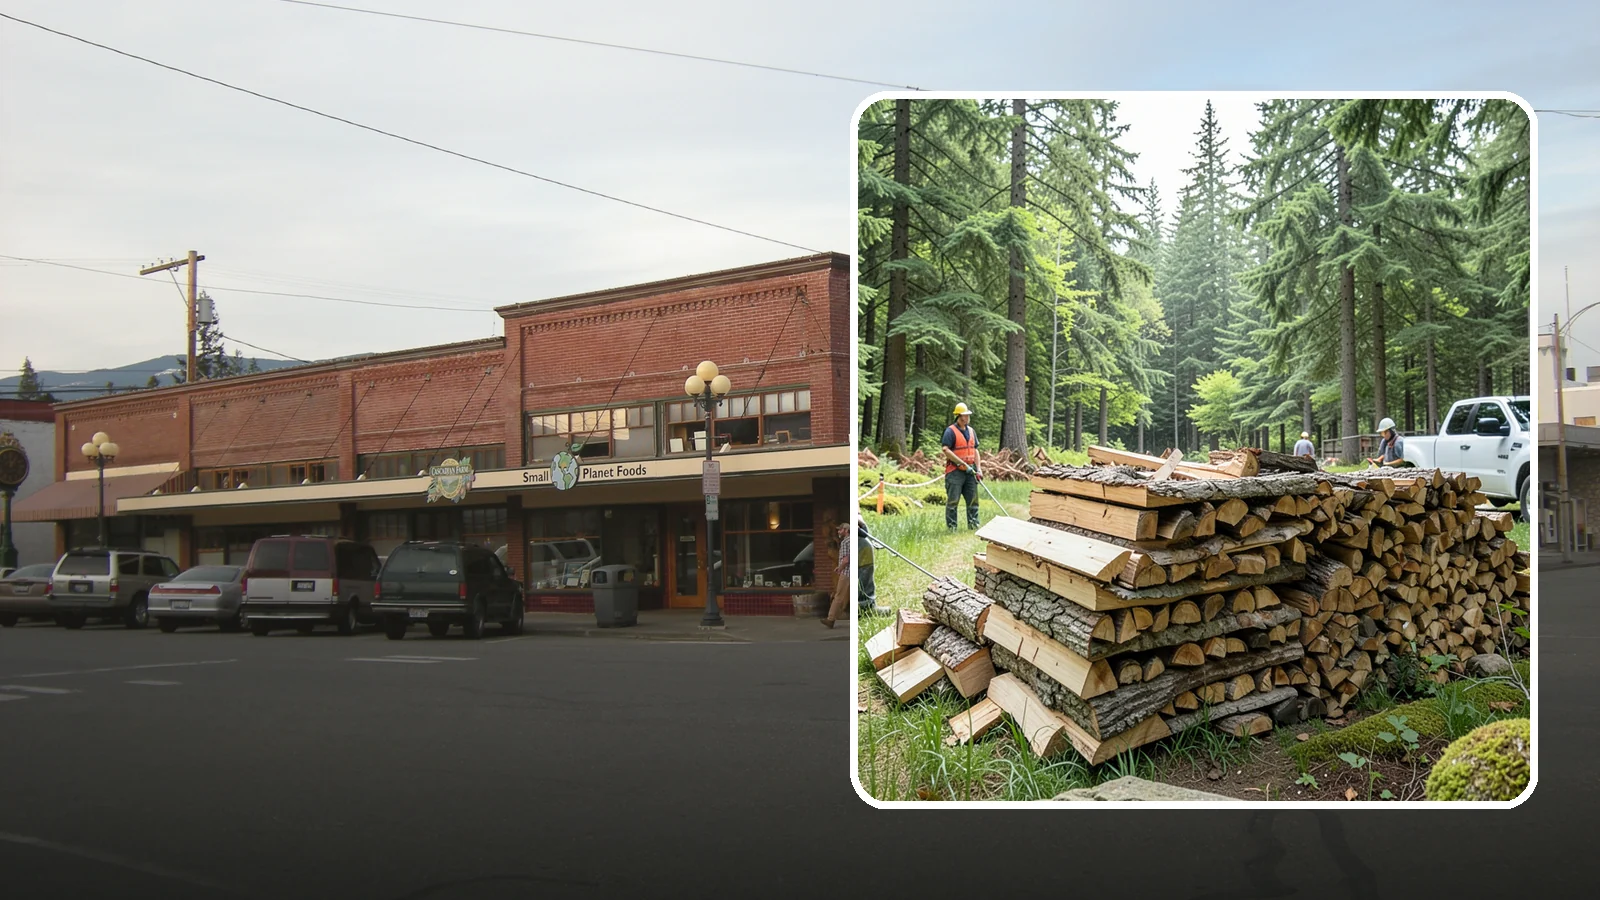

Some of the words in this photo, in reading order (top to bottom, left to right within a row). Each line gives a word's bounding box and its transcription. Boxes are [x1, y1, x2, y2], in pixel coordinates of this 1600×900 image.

[431, 467, 456, 475] CASCADIAN
[523, 471, 549, 483] Small
[583, 467, 614, 480] Planet
[617, 464, 647, 477] Foods
